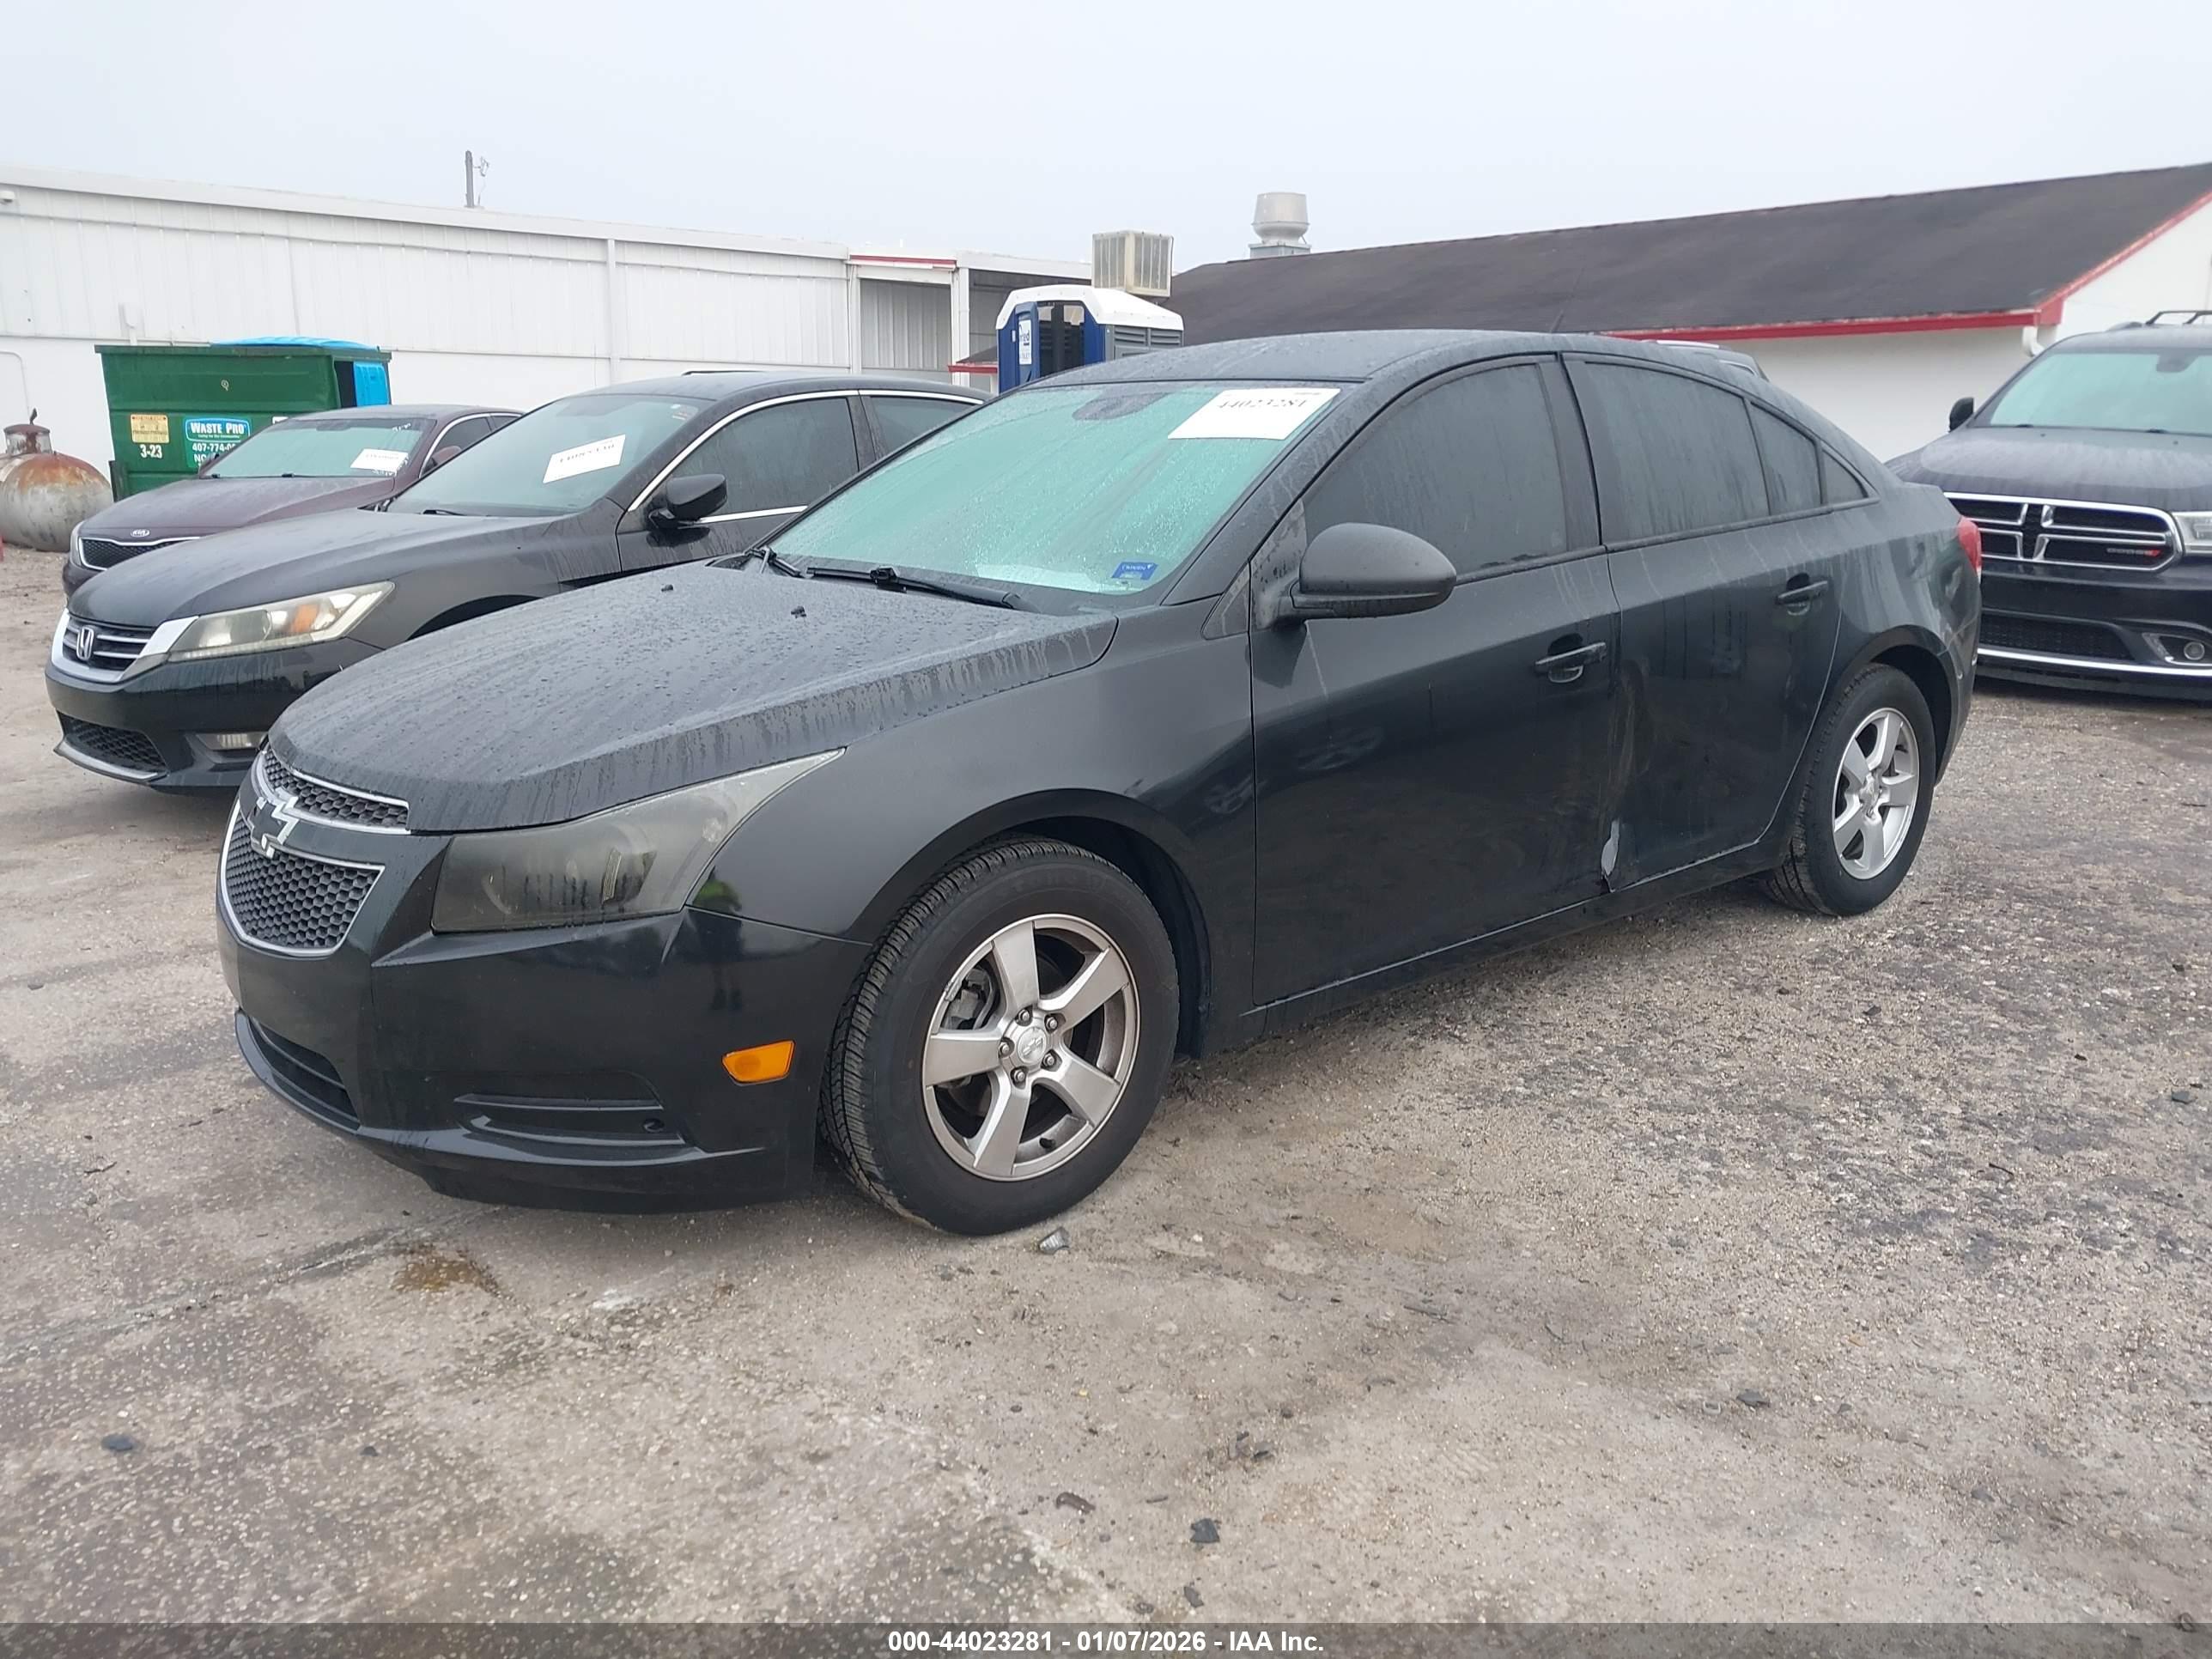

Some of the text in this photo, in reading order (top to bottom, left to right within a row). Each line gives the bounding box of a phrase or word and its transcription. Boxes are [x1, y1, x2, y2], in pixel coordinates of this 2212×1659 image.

[190, 422, 245, 434] WASTE PRO
[140, 444, 163, 459] 3-23
